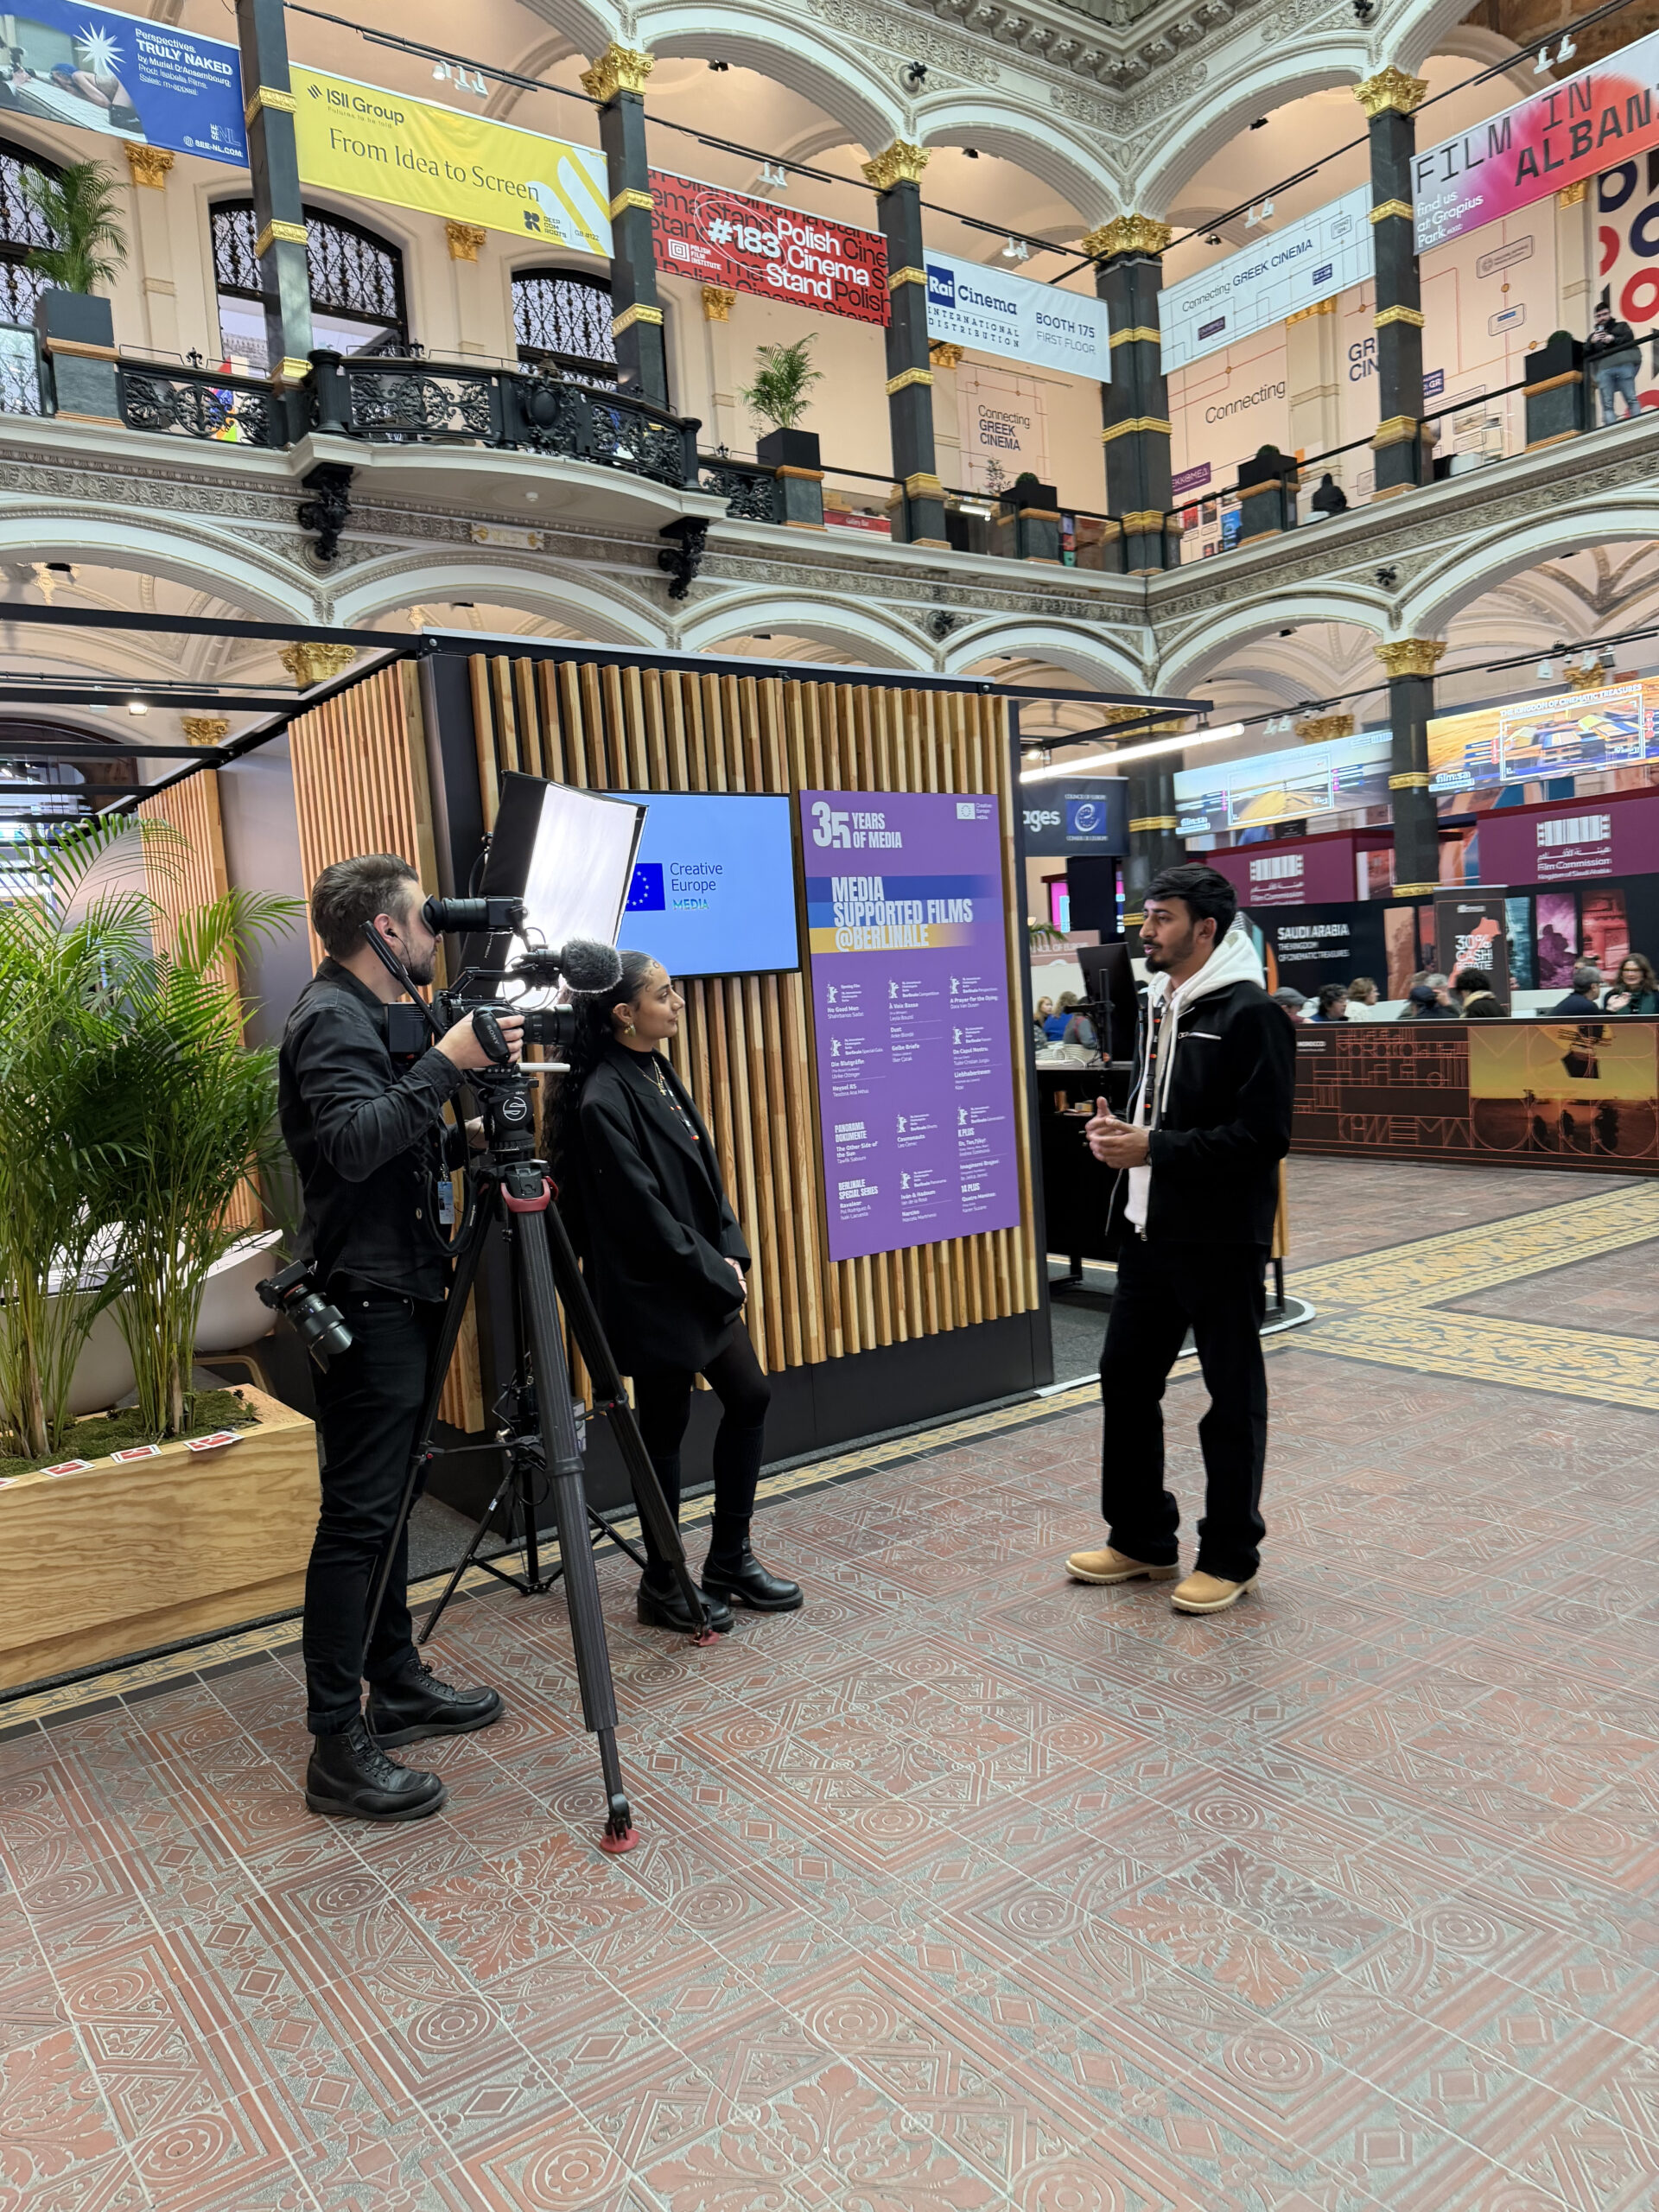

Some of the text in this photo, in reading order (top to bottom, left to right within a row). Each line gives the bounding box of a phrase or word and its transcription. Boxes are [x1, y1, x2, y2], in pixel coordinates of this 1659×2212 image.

[136, 39, 233, 75] TRULY NAKED
[137, 54, 148, 65] by
[149, 57, 173, 70] Muriel
[353, 97, 405, 126] Group
[210, 124, 219, 140] SEE
[1415, 75, 1592, 194] FILM IN
[330, 127, 539, 202] From Idea to Screen
[1417, 190, 1459, 217] find us
[1417, 195, 1484, 233] at Gropius
[709, 217, 781, 258] #183
[778, 217, 841, 257] Polish
[1418, 225, 1447, 248] Park
[690, 244, 711, 255] POLISH
[691, 251, 706, 260] FILM
[690, 257, 722, 270] INSTITUTE
[787, 245, 870, 287] Cinema
[1182, 238, 1313, 312] Connecting GREEK CINEMA
[766, 263, 832, 300] Stand
[929, 276, 954, 298] Rai
[957, 285, 1017, 315] Cinema
[928, 306, 1020, 337] INTERNATIONAL
[928, 317, 1020, 348] DISTRIBUTION
[1036, 312, 1095, 339] BOOTH 175
[1037, 331, 1096, 354] FIRST FLOOR
[1205, 380, 1286, 423] Connecting
[978, 404, 1031, 429] Connecting
[979, 419, 1016, 437] GREEK
[980, 432, 1021, 451] CINEMA
[851, 812, 886, 830] YEARS
[853, 831, 902, 849] OF MEDIA
[670, 862, 723, 876] Creative
[671, 879, 716, 893] Europe
[830, 876, 885, 902] MEDIA
[672, 899, 709, 911] MEDIA
[832, 899, 973, 927] SUPPORTED FILMS
[835, 925, 929, 952] @BERLINALE
[1277, 924, 1350, 940] SAUDI ARABIA
[1454, 934, 1492, 950] 30%
[1455, 949, 1493, 962] CASH
[486, 1024, 500, 1045] SONY
[834, 1122, 865, 1134] PANORAMA
[835, 1130, 868, 1142] DOKUMENTE
[838, 1179, 866, 1191] BERLINALE
[839, 1186, 878, 1200] SPECIAL SERIES
